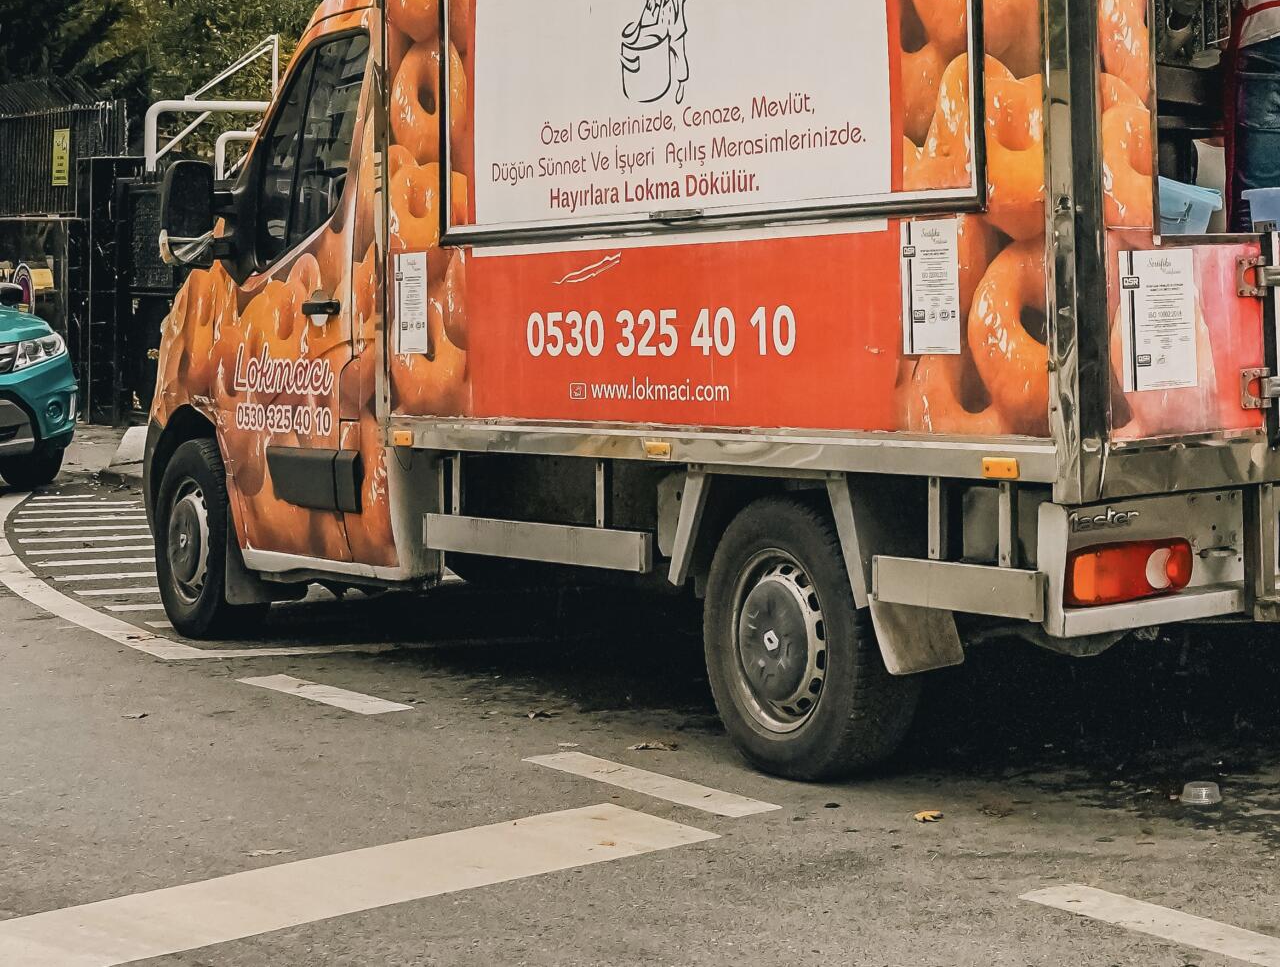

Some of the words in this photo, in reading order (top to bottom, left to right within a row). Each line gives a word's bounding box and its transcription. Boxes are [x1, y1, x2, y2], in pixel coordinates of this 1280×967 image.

[540, 121, 573, 146] Özel
[577, 113, 676, 141] Günlerinizde,
[682, 106, 745, 128] Cenaze,
[751, 92, 815, 121] Mevlüt,
[491, 161, 534, 186] Düğün
[538, 154, 587, 178] Sünnet
[591, 151, 610, 173] Ve
[615, 144, 655, 176] İşyeri
[665, 140, 706, 168] Açılış
[711, 121, 867, 160] Merasimlerinizde.
[549, 182, 620, 213] Hayırlara
[624, 177, 680, 203] Lokma
[685, 169, 760, 197] Dökülür.
[526, 310, 605, 357] 0530
[615, 309, 679, 357] 325
[690, 306, 736, 357] 40
[749, 304, 797, 356] 10
[234, 342, 334, 395] Lokmacı
[591, 376, 730, 402] www.lokmaci.com
[236, 402, 266, 431] 0530
[266, 404, 292, 433] 325
[293, 405, 312, 434] 40
[314, 407, 333, 436] 10
